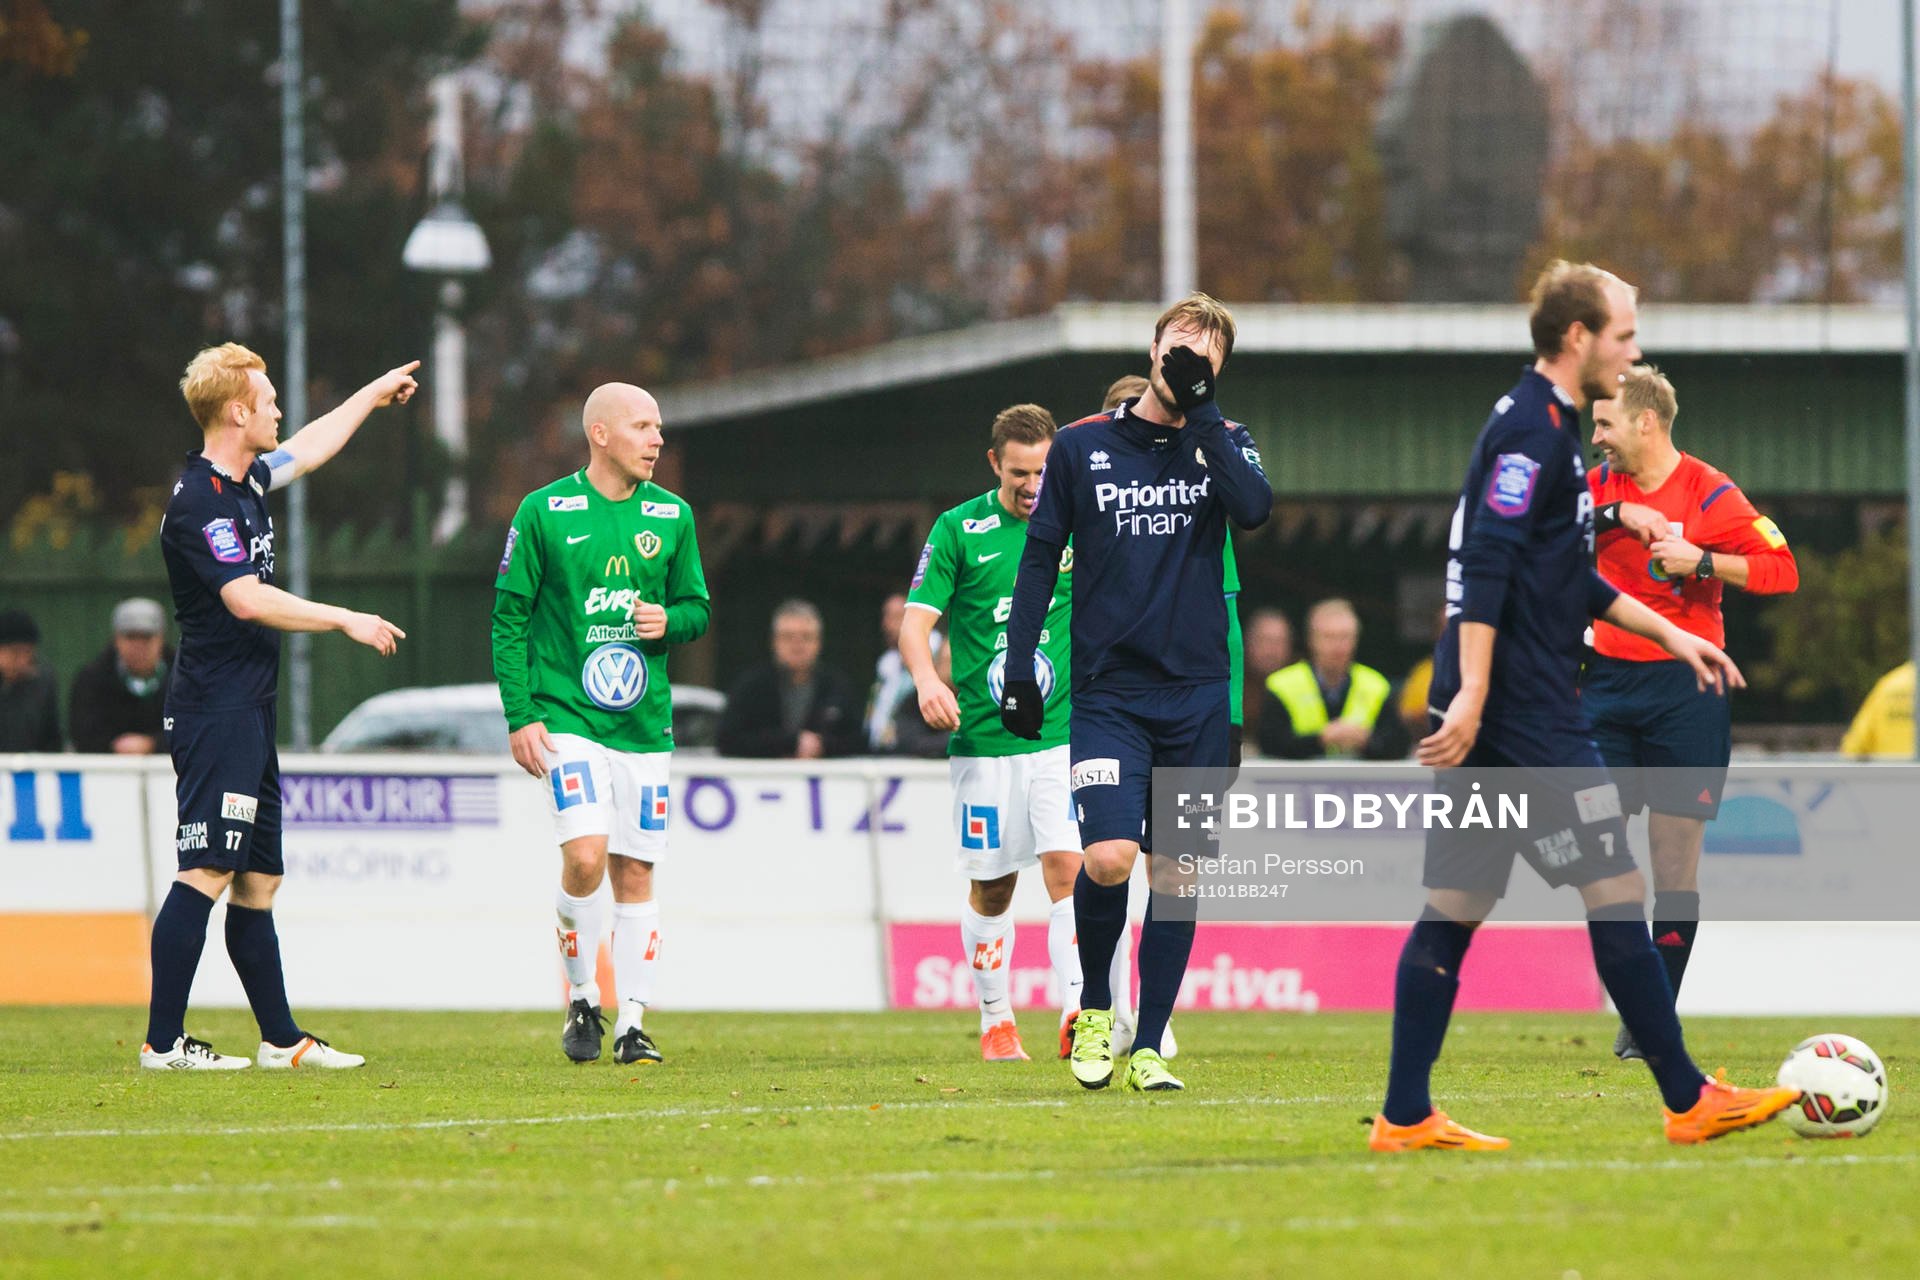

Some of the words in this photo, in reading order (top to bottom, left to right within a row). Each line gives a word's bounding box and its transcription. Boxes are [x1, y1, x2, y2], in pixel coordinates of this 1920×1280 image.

[1115, 508, 1192, 536] Finan
[586, 622, 640, 643] Attevik
[282, 776, 447, 822] XIKURIR
[226, 803, 256, 819] RAST
[179, 822, 208, 838] TEAM
[225, 830, 243, 851] 17
[176, 835, 208, 852] PORTIA
[1599, 832, 1614, 857] 7
[1182, 953, 1320, 1013] riva.
